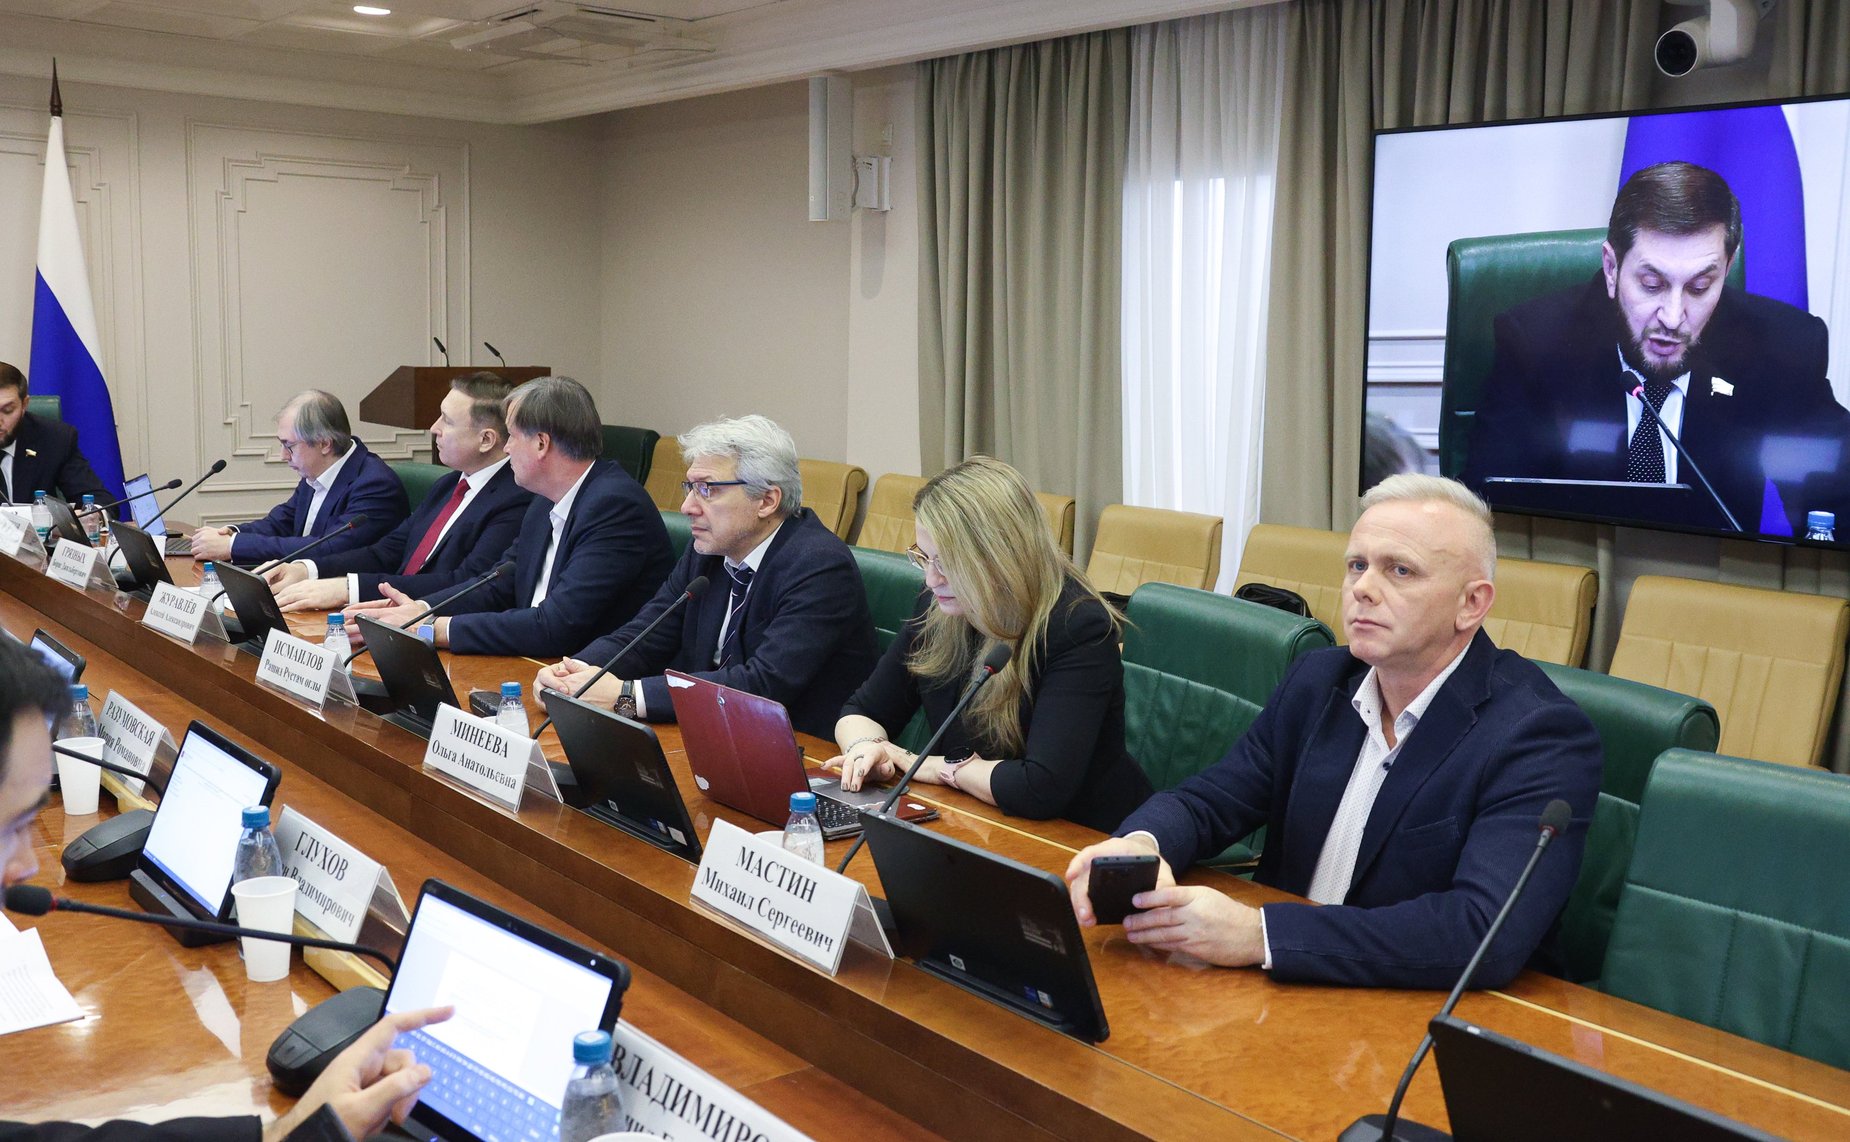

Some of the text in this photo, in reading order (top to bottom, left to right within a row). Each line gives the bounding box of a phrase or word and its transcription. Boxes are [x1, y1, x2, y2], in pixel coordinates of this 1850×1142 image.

[160, 591, 197, 615] ЖУРАВЛЁВ
[273, 640, 324, 671] ИСМАИЛОВ
[283, 667, 305, 685] Рустам
[304, 679, 322, 692] оглы
[105, 701, 156, 747] РАЗУМОВСКАЯ
[450, 719, 508, 759] МИНЕЕВА
[113, 737, 146, 772] Романовна
[432, 740, 517, 790] Ольга Анатольевна
[294, 831, 349, 881] ГЛУХОВ
[735, 846, 818, 904] МАСТИН
[701, 867, 834, 953] Михаил Сергеевич
